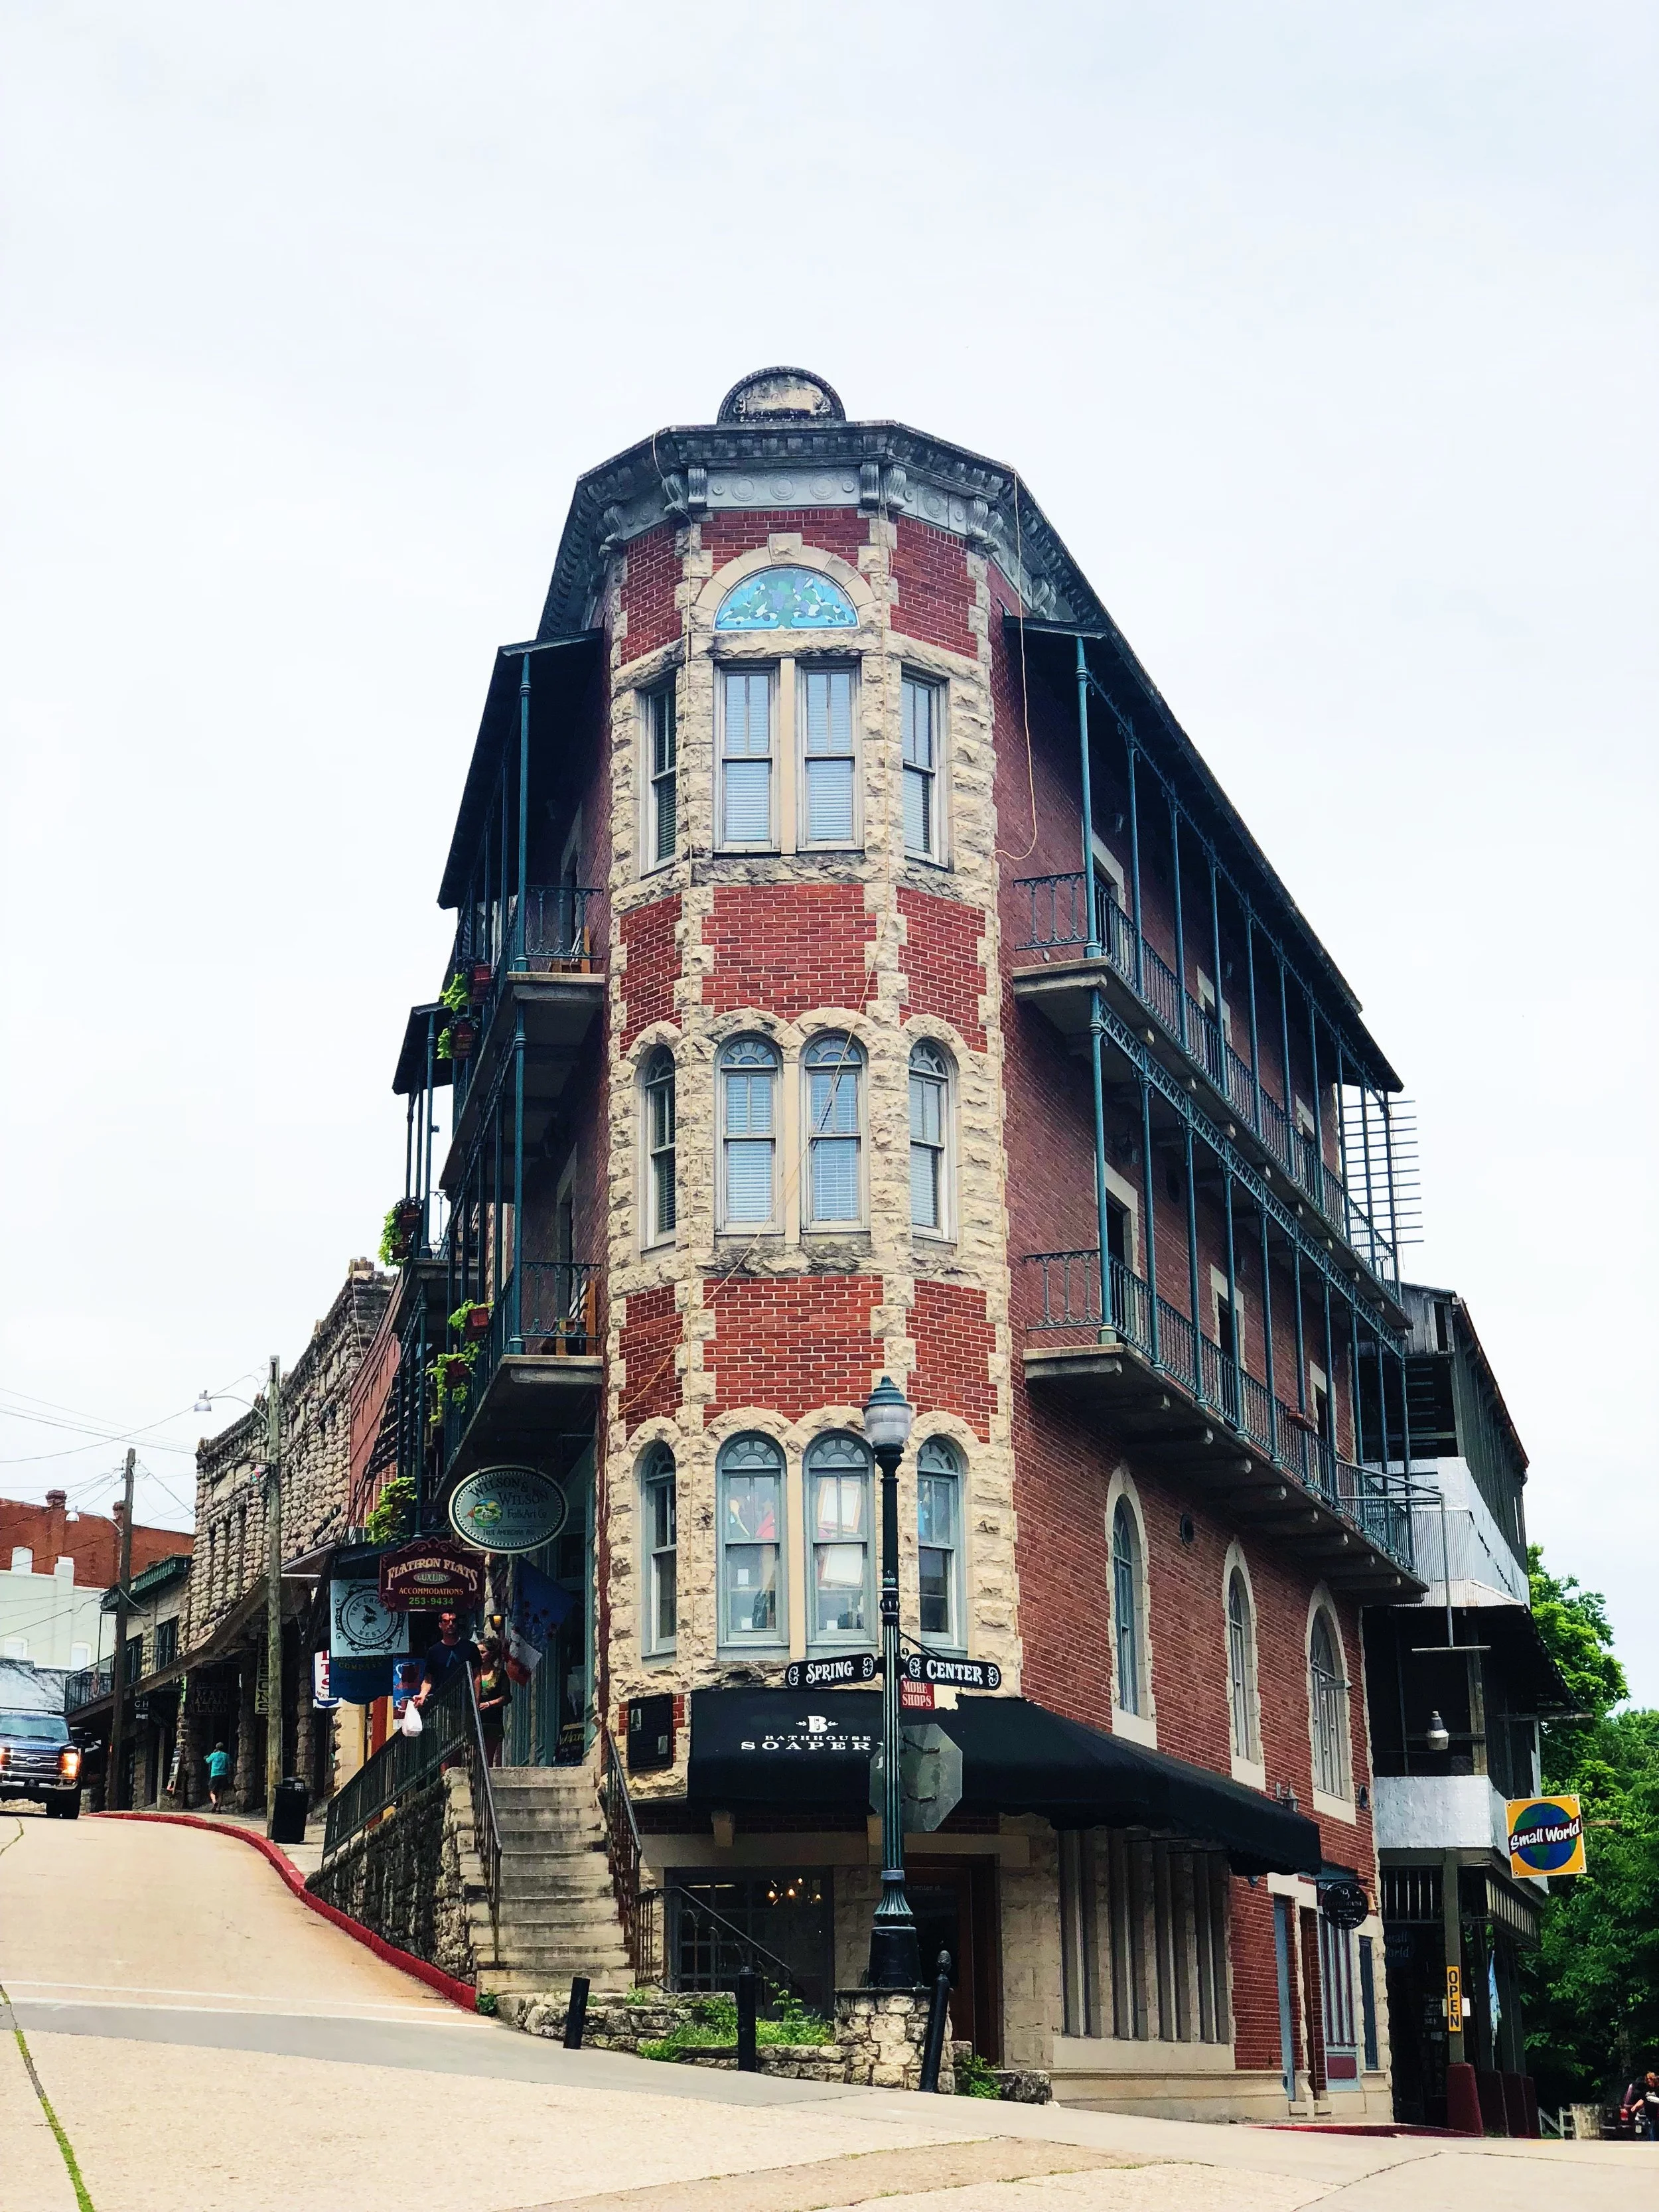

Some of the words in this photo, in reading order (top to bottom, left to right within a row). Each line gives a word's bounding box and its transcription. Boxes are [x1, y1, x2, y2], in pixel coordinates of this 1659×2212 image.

[469, 1477, 520, 1499] WILSON
[520, 1481, 529, 1493] &
[498, 1489, 550, 1506] WILSON
[386, 1558, 441, 1591] FLATIRON
[443, 1559, 478, 1591] FLATS
[417, 1573, 448, 1582] LUXURY
[398, 1587, 464, 1595] ACCOMMODATIONS
[350, 1598, 362, 1616] THE
[408, 1597, 454, 1605] 253-9434
[358, 1628, 382, 1638] NEST
[806, 1660, 855, 1684] SPRING
[926, 1659, 983, 1685] CENTER
[902, 1680, 928, 1694] MORE
[902, 1694, 932, 1707] SHOPS
[741, 1741, 884, 1750] SOAPER
[1510, 1828, 1544, 1850] Small
[1545, 1818, 1580, 1842] World
[1448, 1970, 1459, 2028] OPEN
